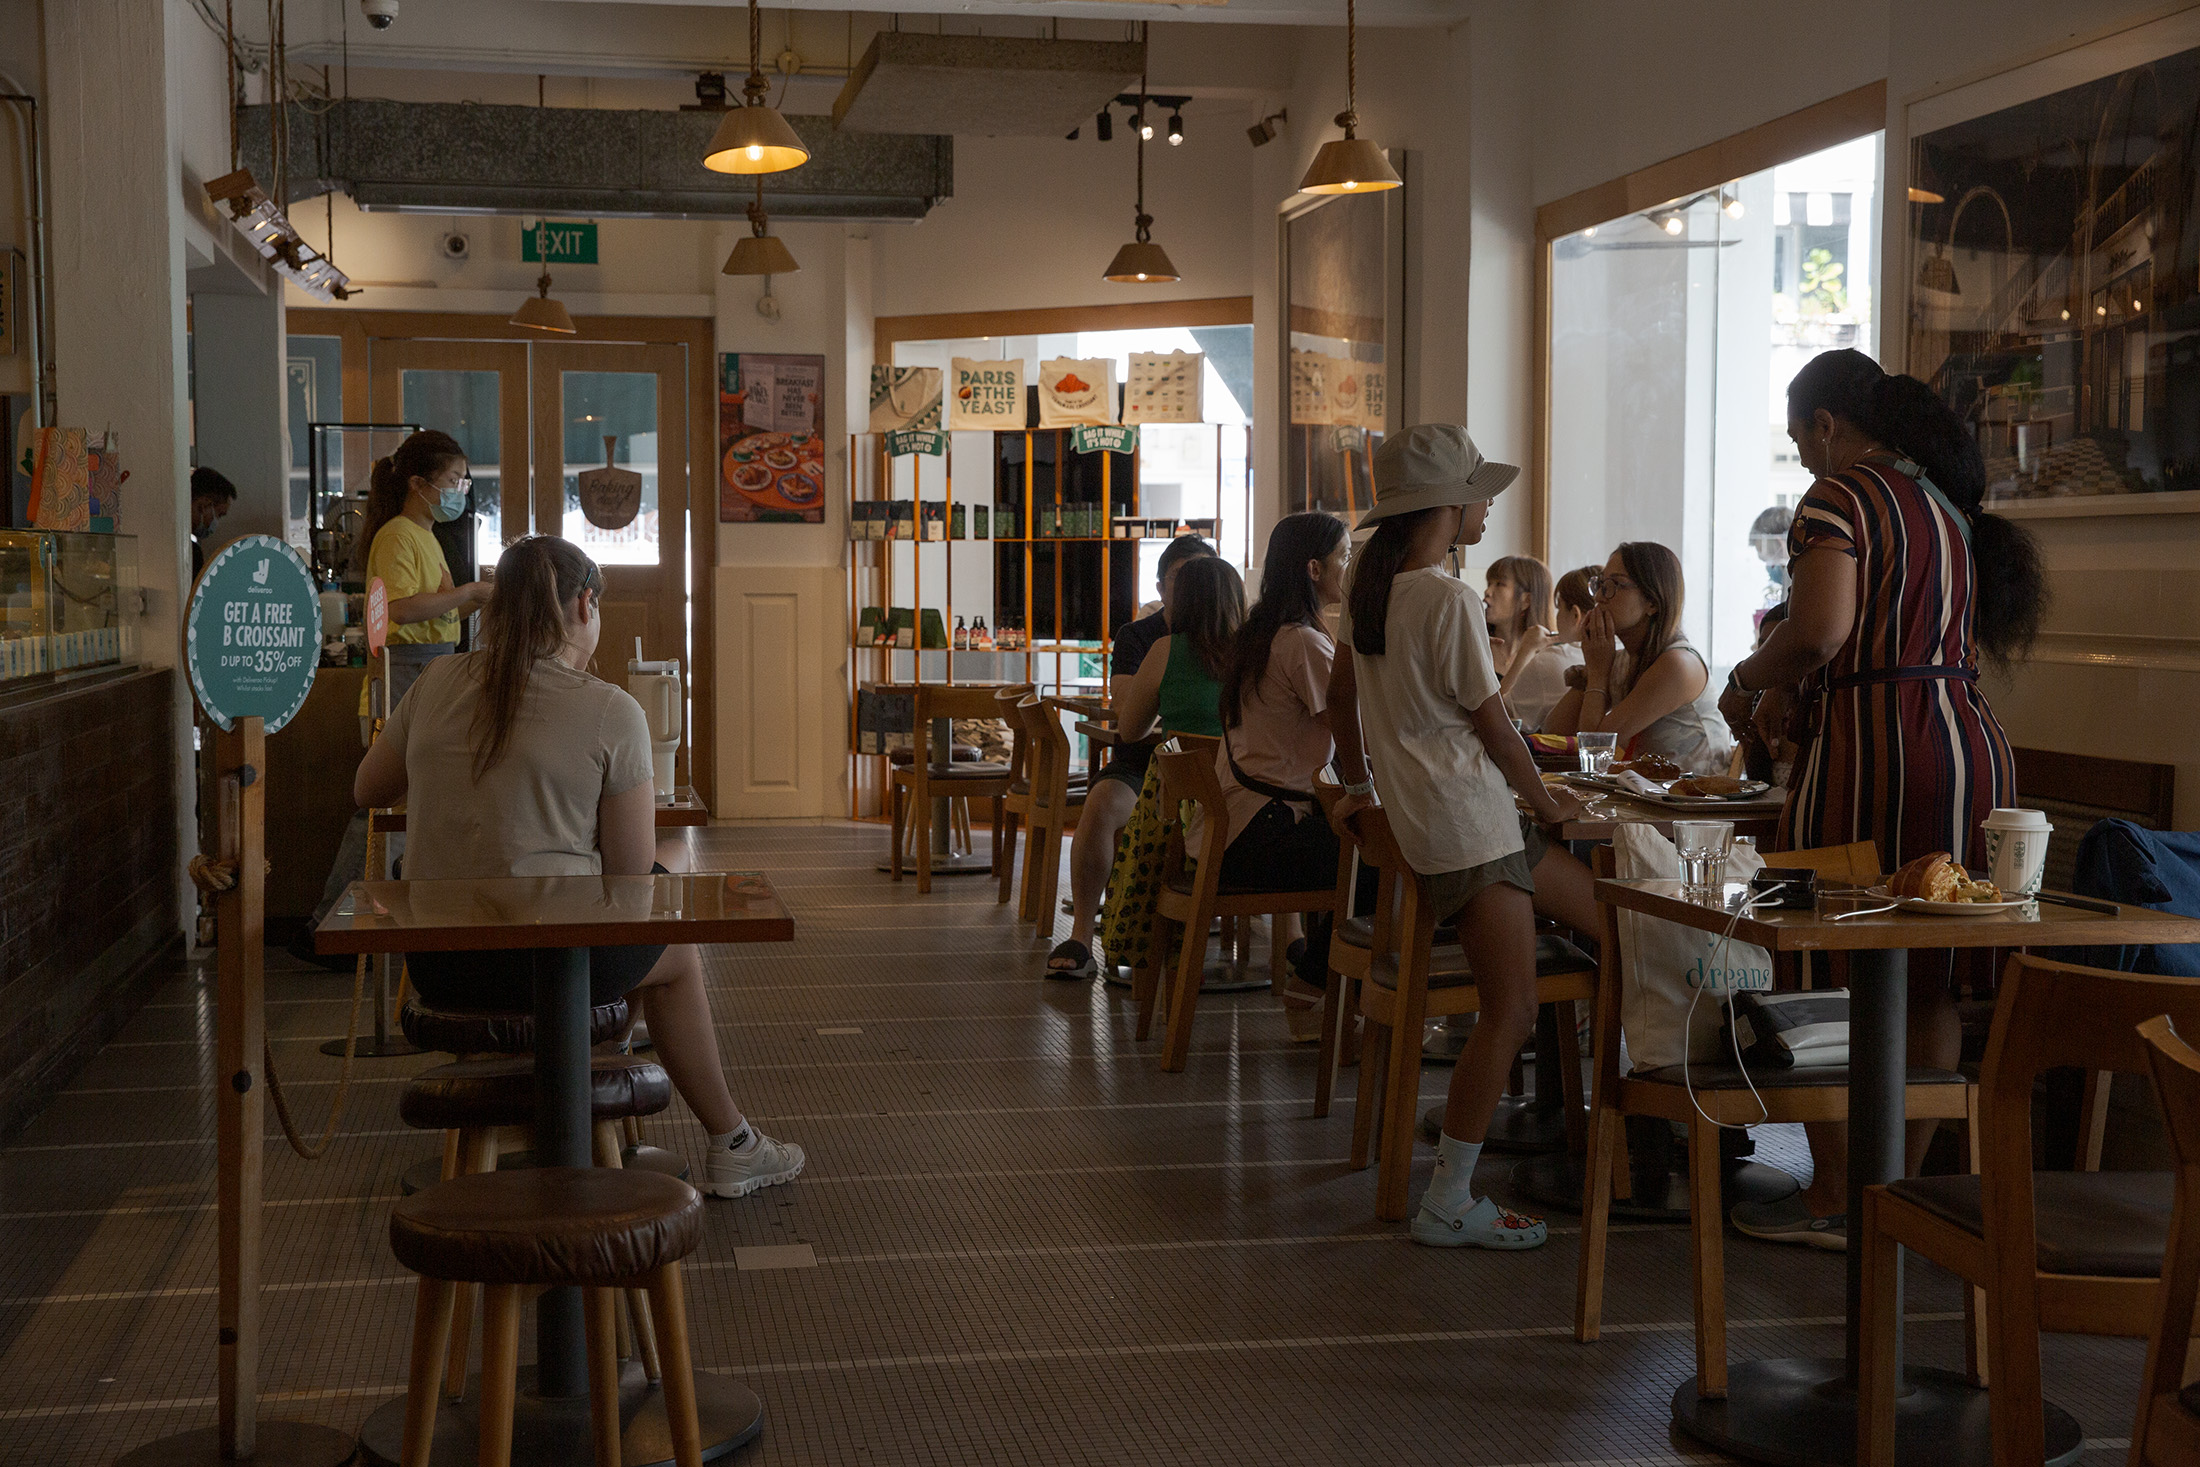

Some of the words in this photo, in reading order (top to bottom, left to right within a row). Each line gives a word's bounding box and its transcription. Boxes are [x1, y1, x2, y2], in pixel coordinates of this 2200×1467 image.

[536, 229, 584, 255] EXIT
[776, 378, 813, 388] BREAKFAST
[960, 370, 1016, 385] PARIS
[787, 387, 801, 395] HAS
[983, 387, 1015, 399] THE
[782, 394, 805, 403] NEVER
[785, 402, 802, 410] BEEN
[960, 400, 1016, 414] YEAST
[909, 433, 915, 442] IT
[915, 433, 936, 445] WHILE
[1097, 428, 1104, 437] IT
[1105, 428, 1126, 440] WHILE
[247, 585, 273, 594] deliveroo
[370, 586, 384, 609] PLEASE
[224, 601, 249, 623] GET
[251, 602, 261, 624] A
[264, 603, 293, 625] FREE
[374, 600, 385, 620] HERE
[223, 625, 232, 647] B
[235, 625, 306, 648] CROISSANT
[229, 655, 240, 667] UP
[242, 655, 253, 667] TO
[254, 650, 287, 673] 35%
[287, 656, 302, 668] OFF
[733, 1129, 748, 1144] NIKE
